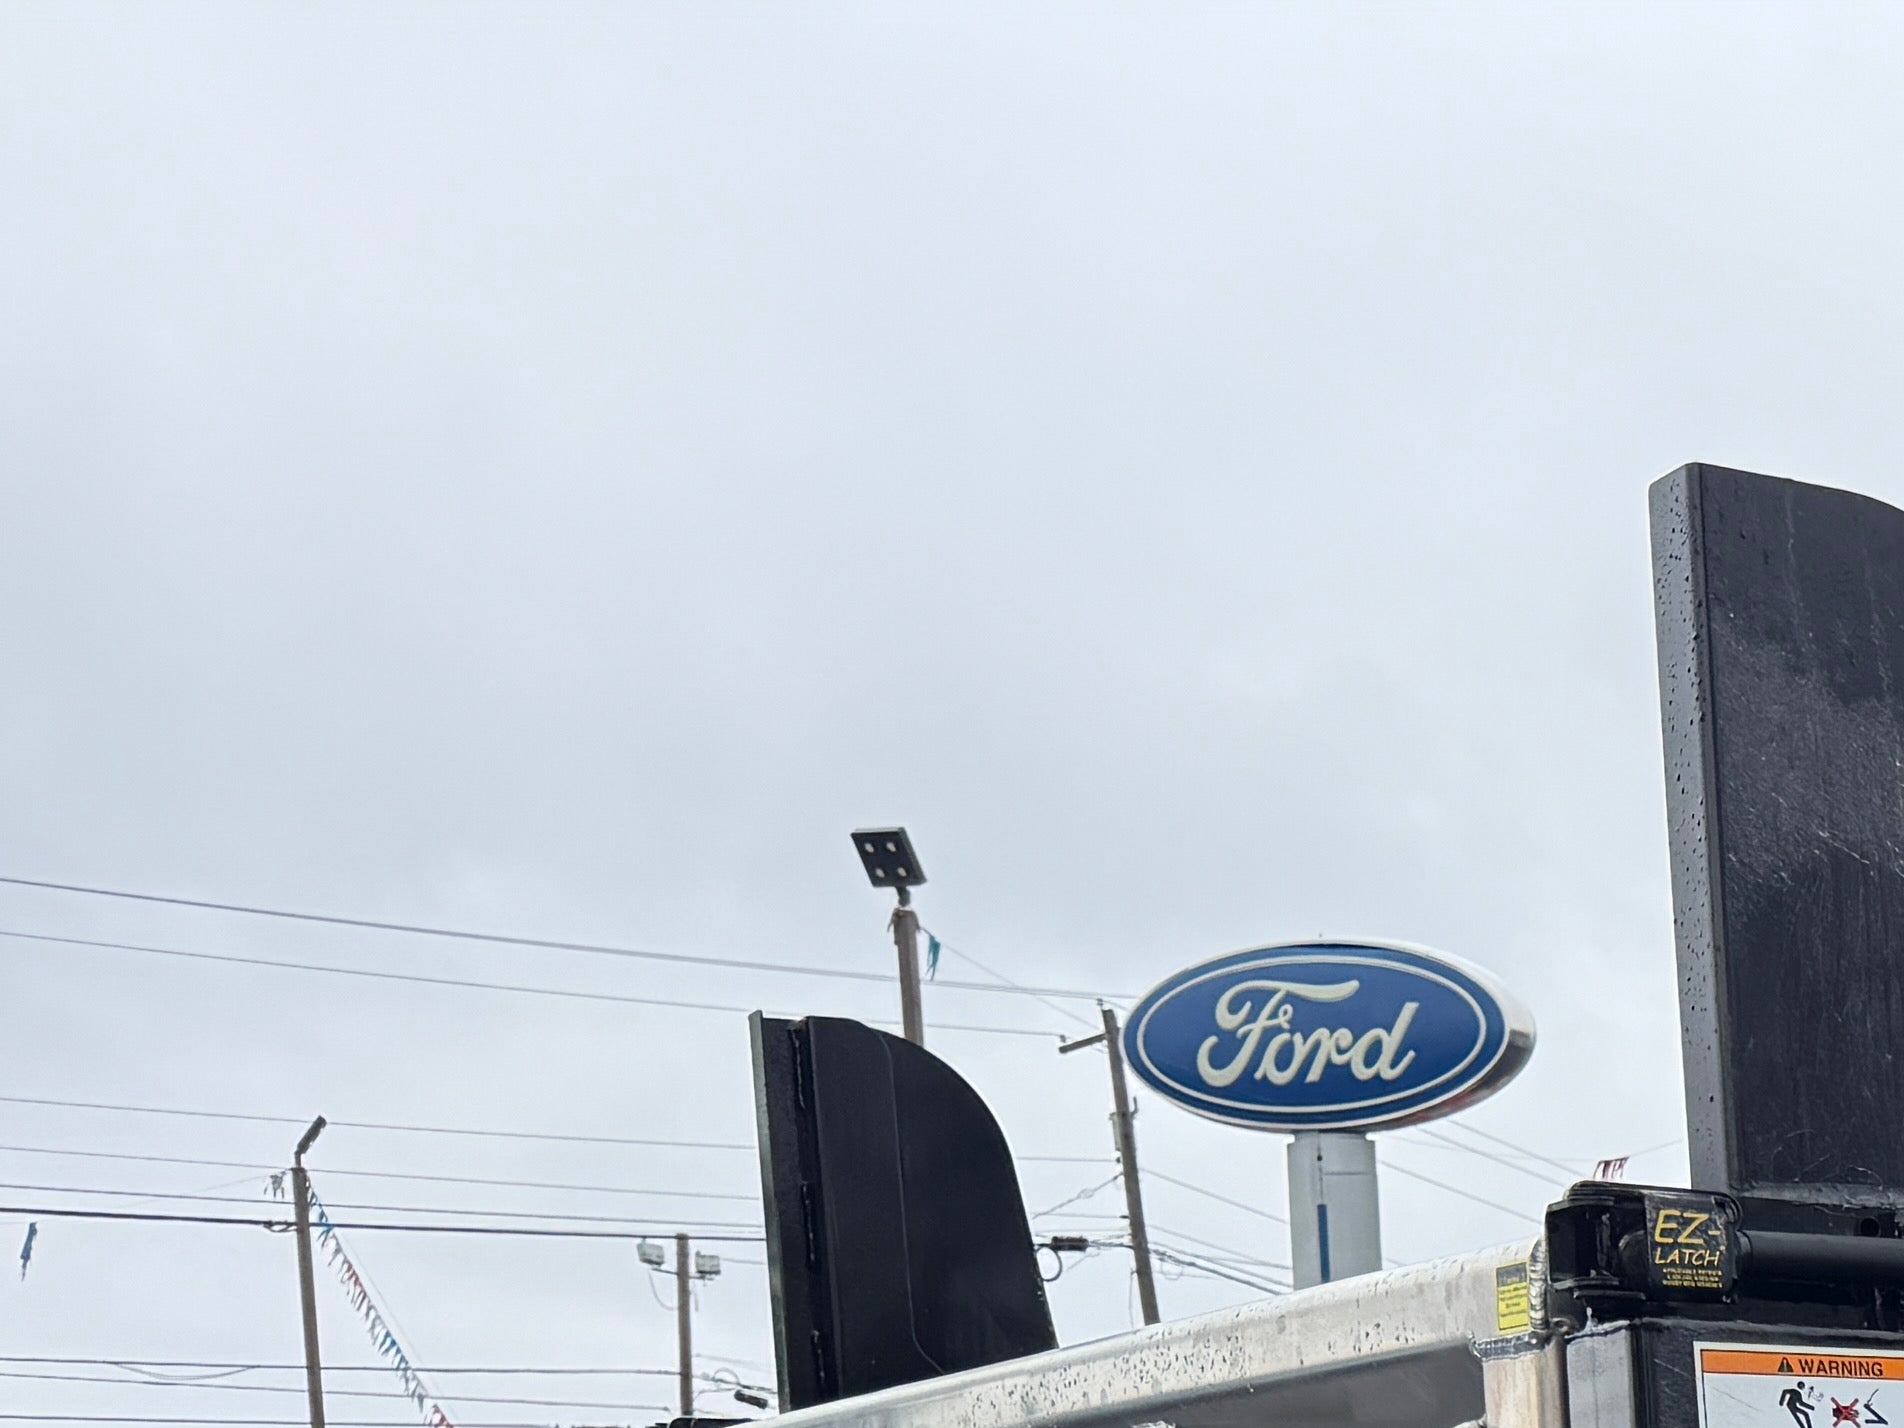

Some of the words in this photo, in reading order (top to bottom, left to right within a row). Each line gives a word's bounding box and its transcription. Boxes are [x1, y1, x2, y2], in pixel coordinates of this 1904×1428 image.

[1197, 979, 1420, 1088] Ford
[1654, 1246, 1721, 1267] LATCH
[1798, 1357, 1884, 1378] WARNING
